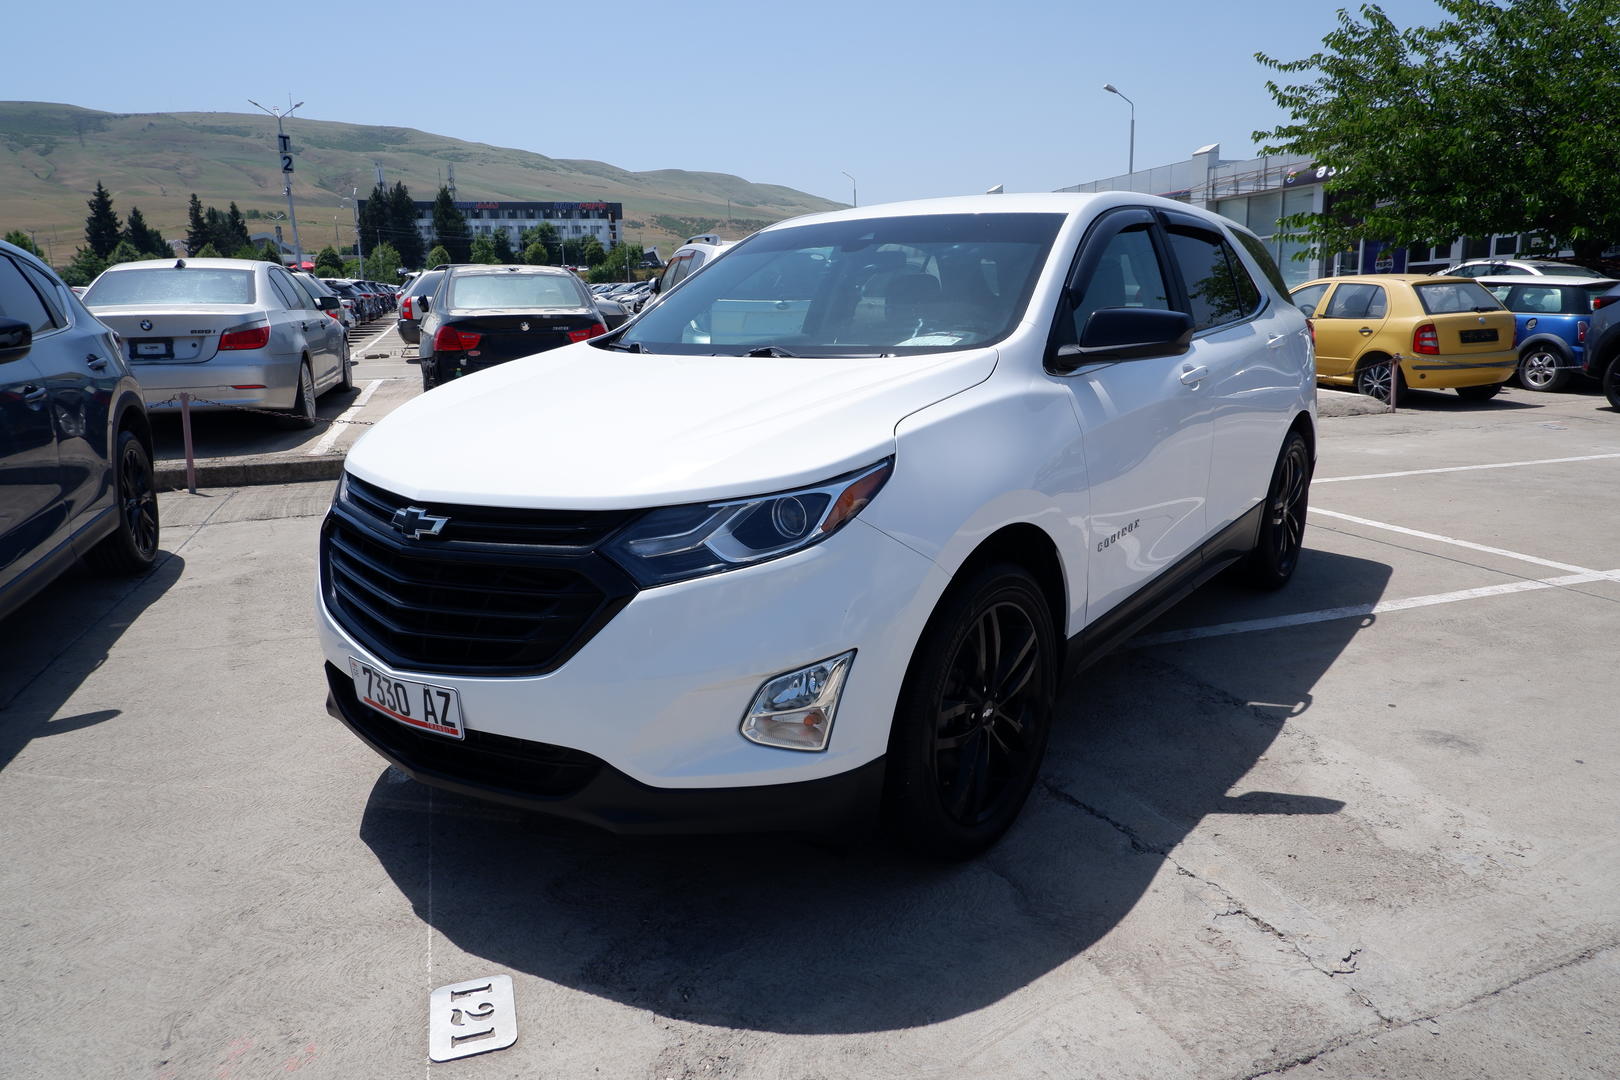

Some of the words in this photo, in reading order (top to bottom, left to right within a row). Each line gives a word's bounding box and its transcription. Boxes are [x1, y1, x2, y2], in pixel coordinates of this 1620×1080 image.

[278, 134, 290, 152] T
[282, 156, 293, 171] 2
[362, 666, 411, 717] 7330
[423, 687, 456, 728] AZ
[450, 983, 497, 1049] 121
